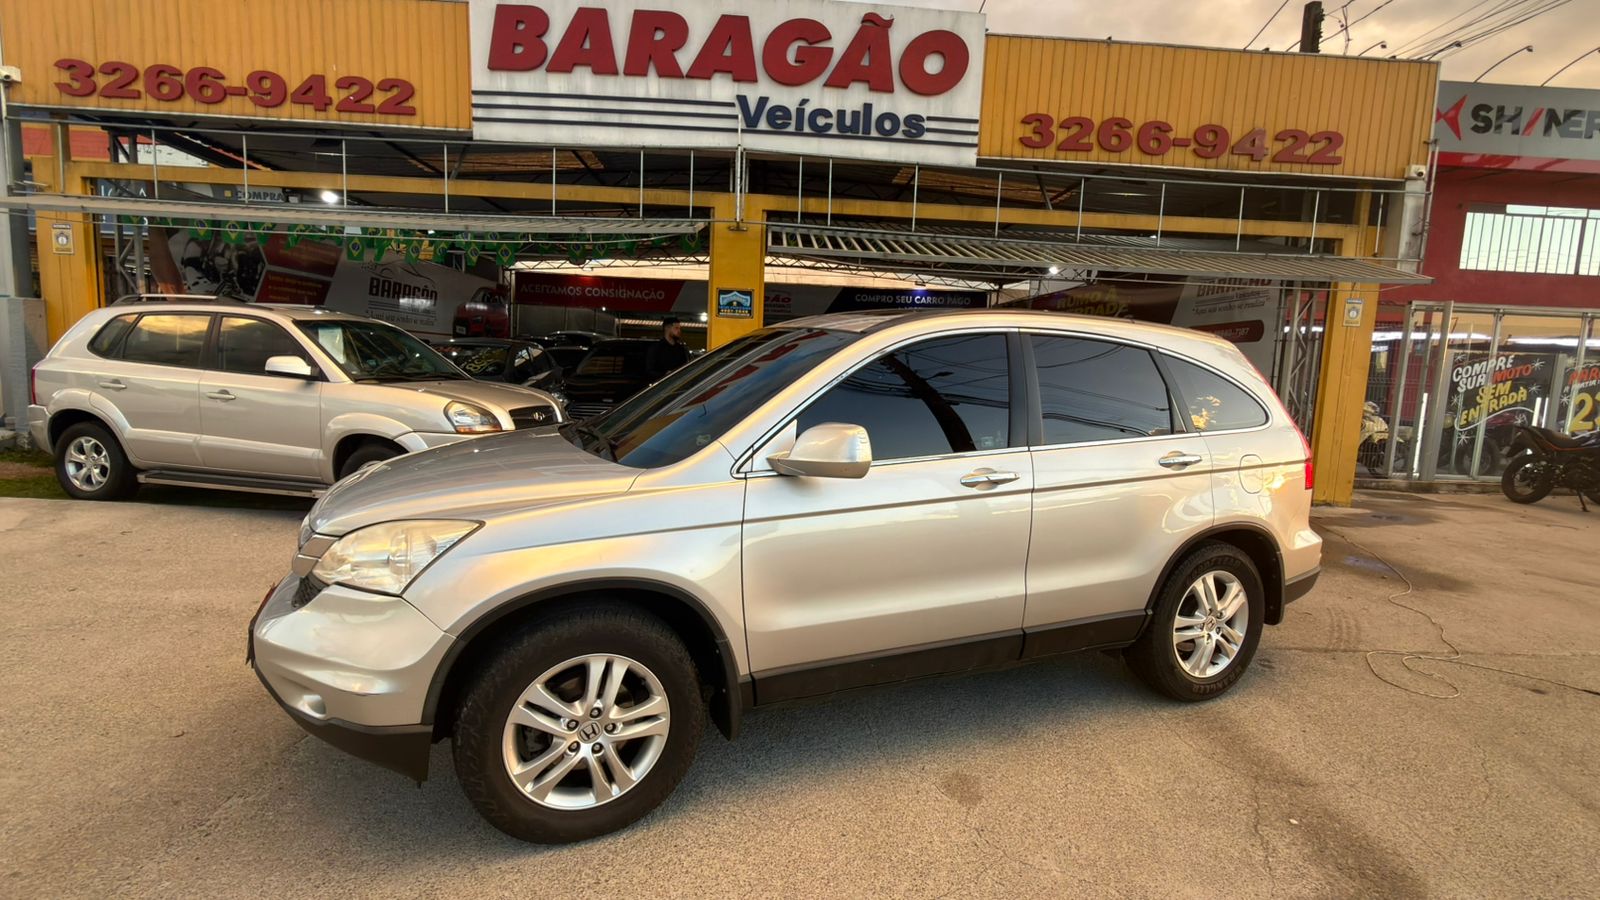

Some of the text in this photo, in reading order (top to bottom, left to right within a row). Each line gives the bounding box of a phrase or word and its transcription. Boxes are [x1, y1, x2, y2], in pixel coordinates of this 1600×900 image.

[488, 3, 970, 96] BARAGÃO
[53, 58, 416, 116] 3266-9422
[736, 94, 927, 139] Veículos
[1019, 112, 1345, 166] 3266-9422
[519, 282, 666, 303] ACEITAMOS CONSIGNAÇÃO
[855, 293, 972, 306] COMPRO SEU CARRO PAGO
[1452, 354, 1516, 382] COMPRE
[1457, 363, 1532, 393] SUA MOTO
[1476, 380, 1513, 405] SEM
